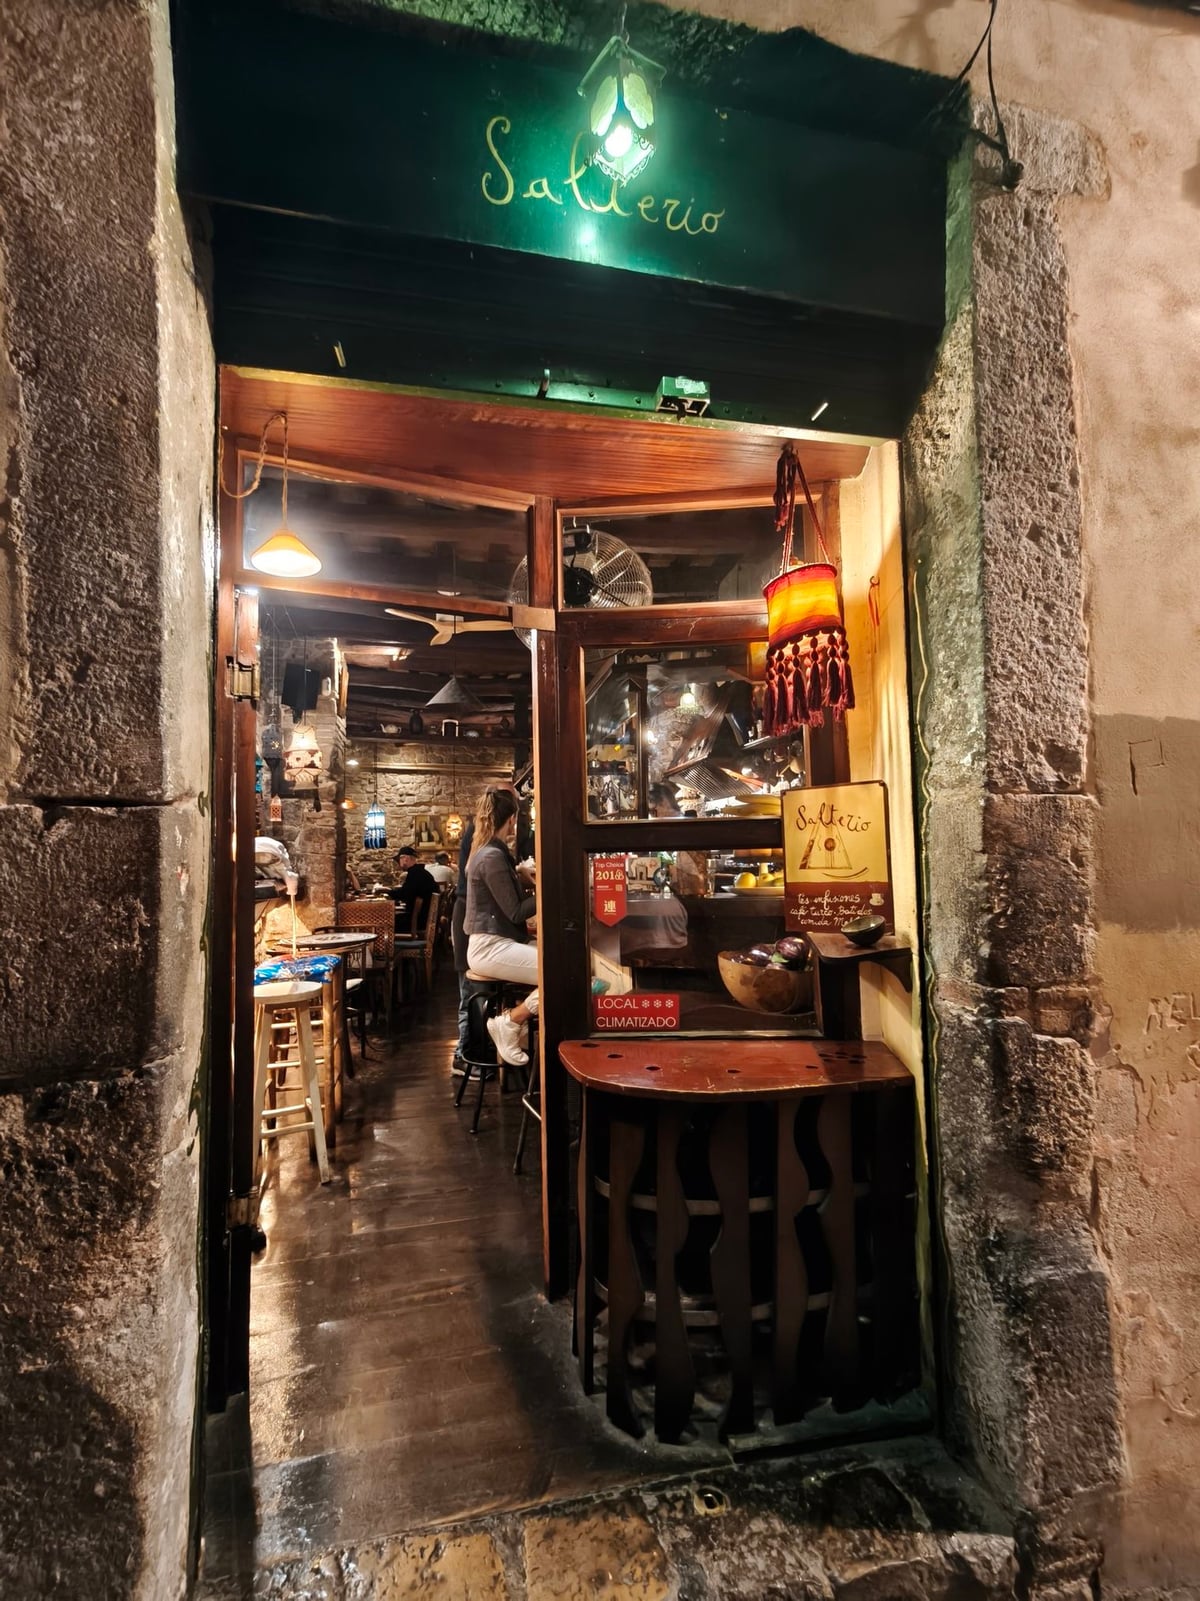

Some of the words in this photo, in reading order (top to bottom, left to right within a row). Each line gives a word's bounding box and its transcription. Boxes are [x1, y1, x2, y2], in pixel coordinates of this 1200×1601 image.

[795, 802, 872, 832] Salterio
[597, 998, 639, 1009] LOCAL
[596, 1016, 676, 1028] CLIMATIZADO
